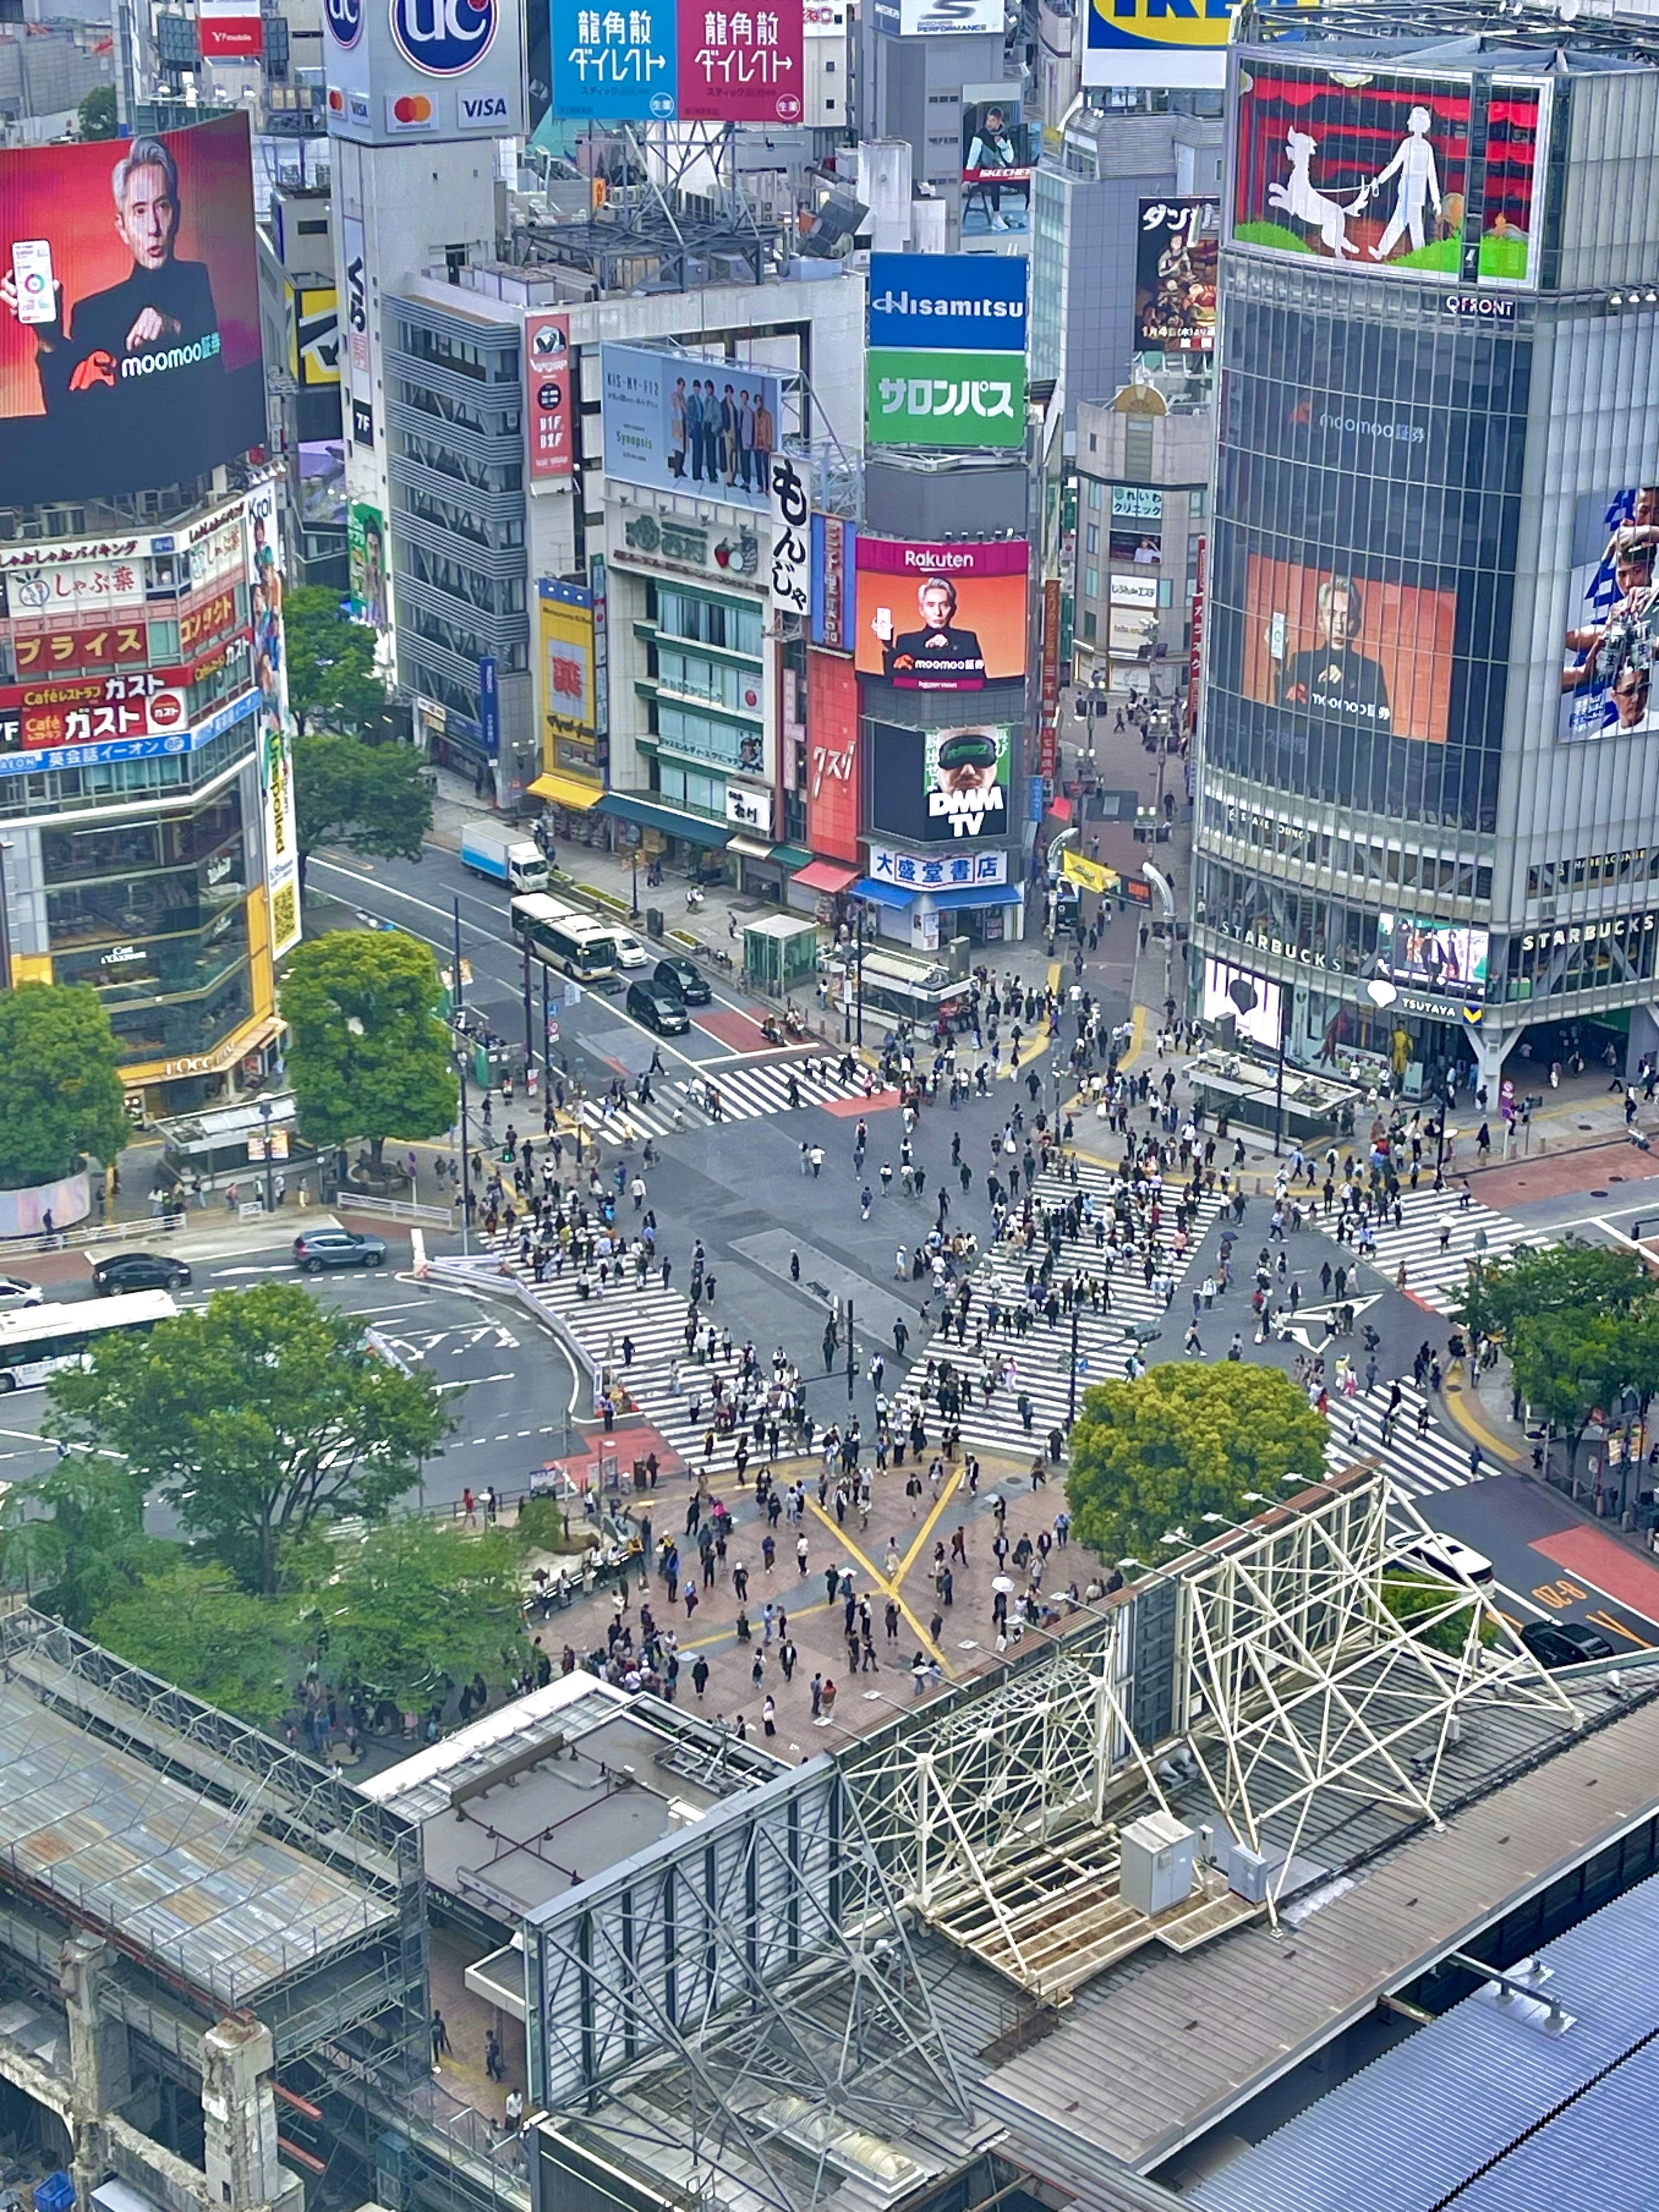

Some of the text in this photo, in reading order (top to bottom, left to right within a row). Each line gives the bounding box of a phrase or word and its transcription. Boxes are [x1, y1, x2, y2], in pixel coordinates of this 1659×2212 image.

[578, 10, 652, 44] 龍角散
[704, 10, 779, 46] 龍角散
[568, 47, 666, 81] ダイレクト
[694, 49, 793, 83] ダイレクト
[351, 100, 368, 118] VISA
[462, 98, 507, 117] VISA
[872, 290, 1024, 318] Hisamitsu
[1446, 295, 1513, 317] QFRONT
[878, 377, 1014, 419] サロンパス
[357, 412, 370, 431] 7F
[616, 430, 653, 450] Synopsis
[248, 488, 273, 527] Kroi
[1114, 502, 1161, 516] クリニック
[1126, 490, 1162, 504] れいわ
[772, 458, 808, 611] もんじゃ
[905, 550, 974, 572] Rakuten
[55, 565, 134, 597] しゃぶ葉
[180, 595, 232, 645] コンタクト
[15, 628, 143, 665] プライス
[105, 674, 165, 701] ガスト
[25, 714, 60, 732] Café
[65, 704, 140, 741] ガスト
[48, 739, 160, 768] 英会話イーオン
[929, 786, 1004, 817] DMM
[948, 812, 984, 837] TV
[877, 853, 998, 883] 大盛堂書店
[1221, 921, 1343, 972] STARBUCKS
[1522, 915, 1655, 951] STARBUCKS
[1402, 997, 1456, 1017] TSUTAYA
